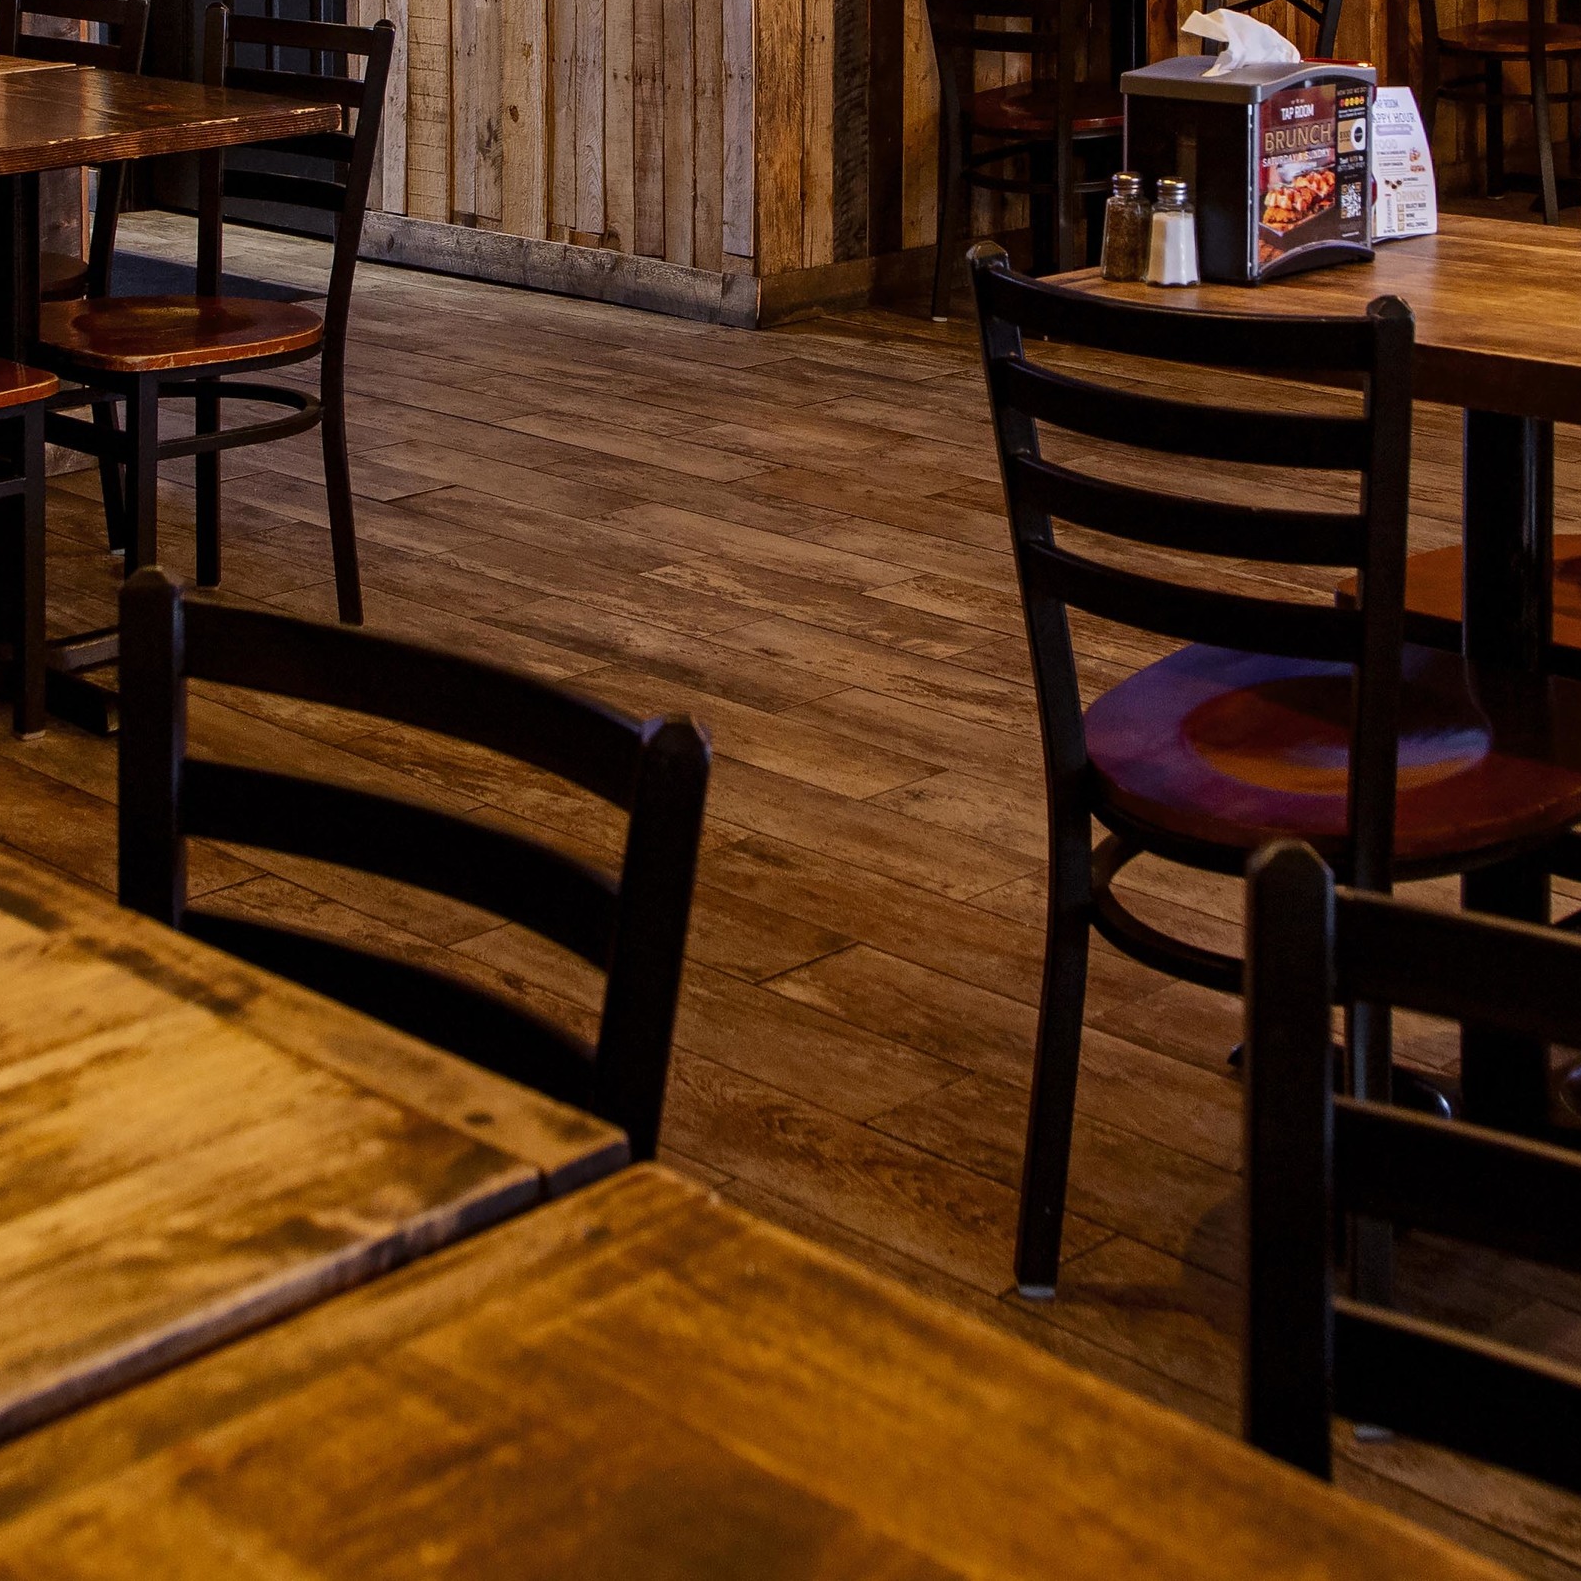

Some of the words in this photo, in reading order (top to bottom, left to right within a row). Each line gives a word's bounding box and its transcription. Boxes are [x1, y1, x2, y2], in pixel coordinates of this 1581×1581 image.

[1384, 99, 1399, 108] ROOM
[1281, 107, 1294, 120] TAP
[1295, 104, 1314, 117] ROOM
[1395, 113, 1416, 123] HOUR
[1265, 123, 1331, 153] BRUNCH
[1375, 139, 1398, 149] FOOD
[1263, 154, 1296, 167] SATURDAY
[1305, 149, 1330, 161] SUNDAY
[1397, 190, 1426, 202] DRINKS
